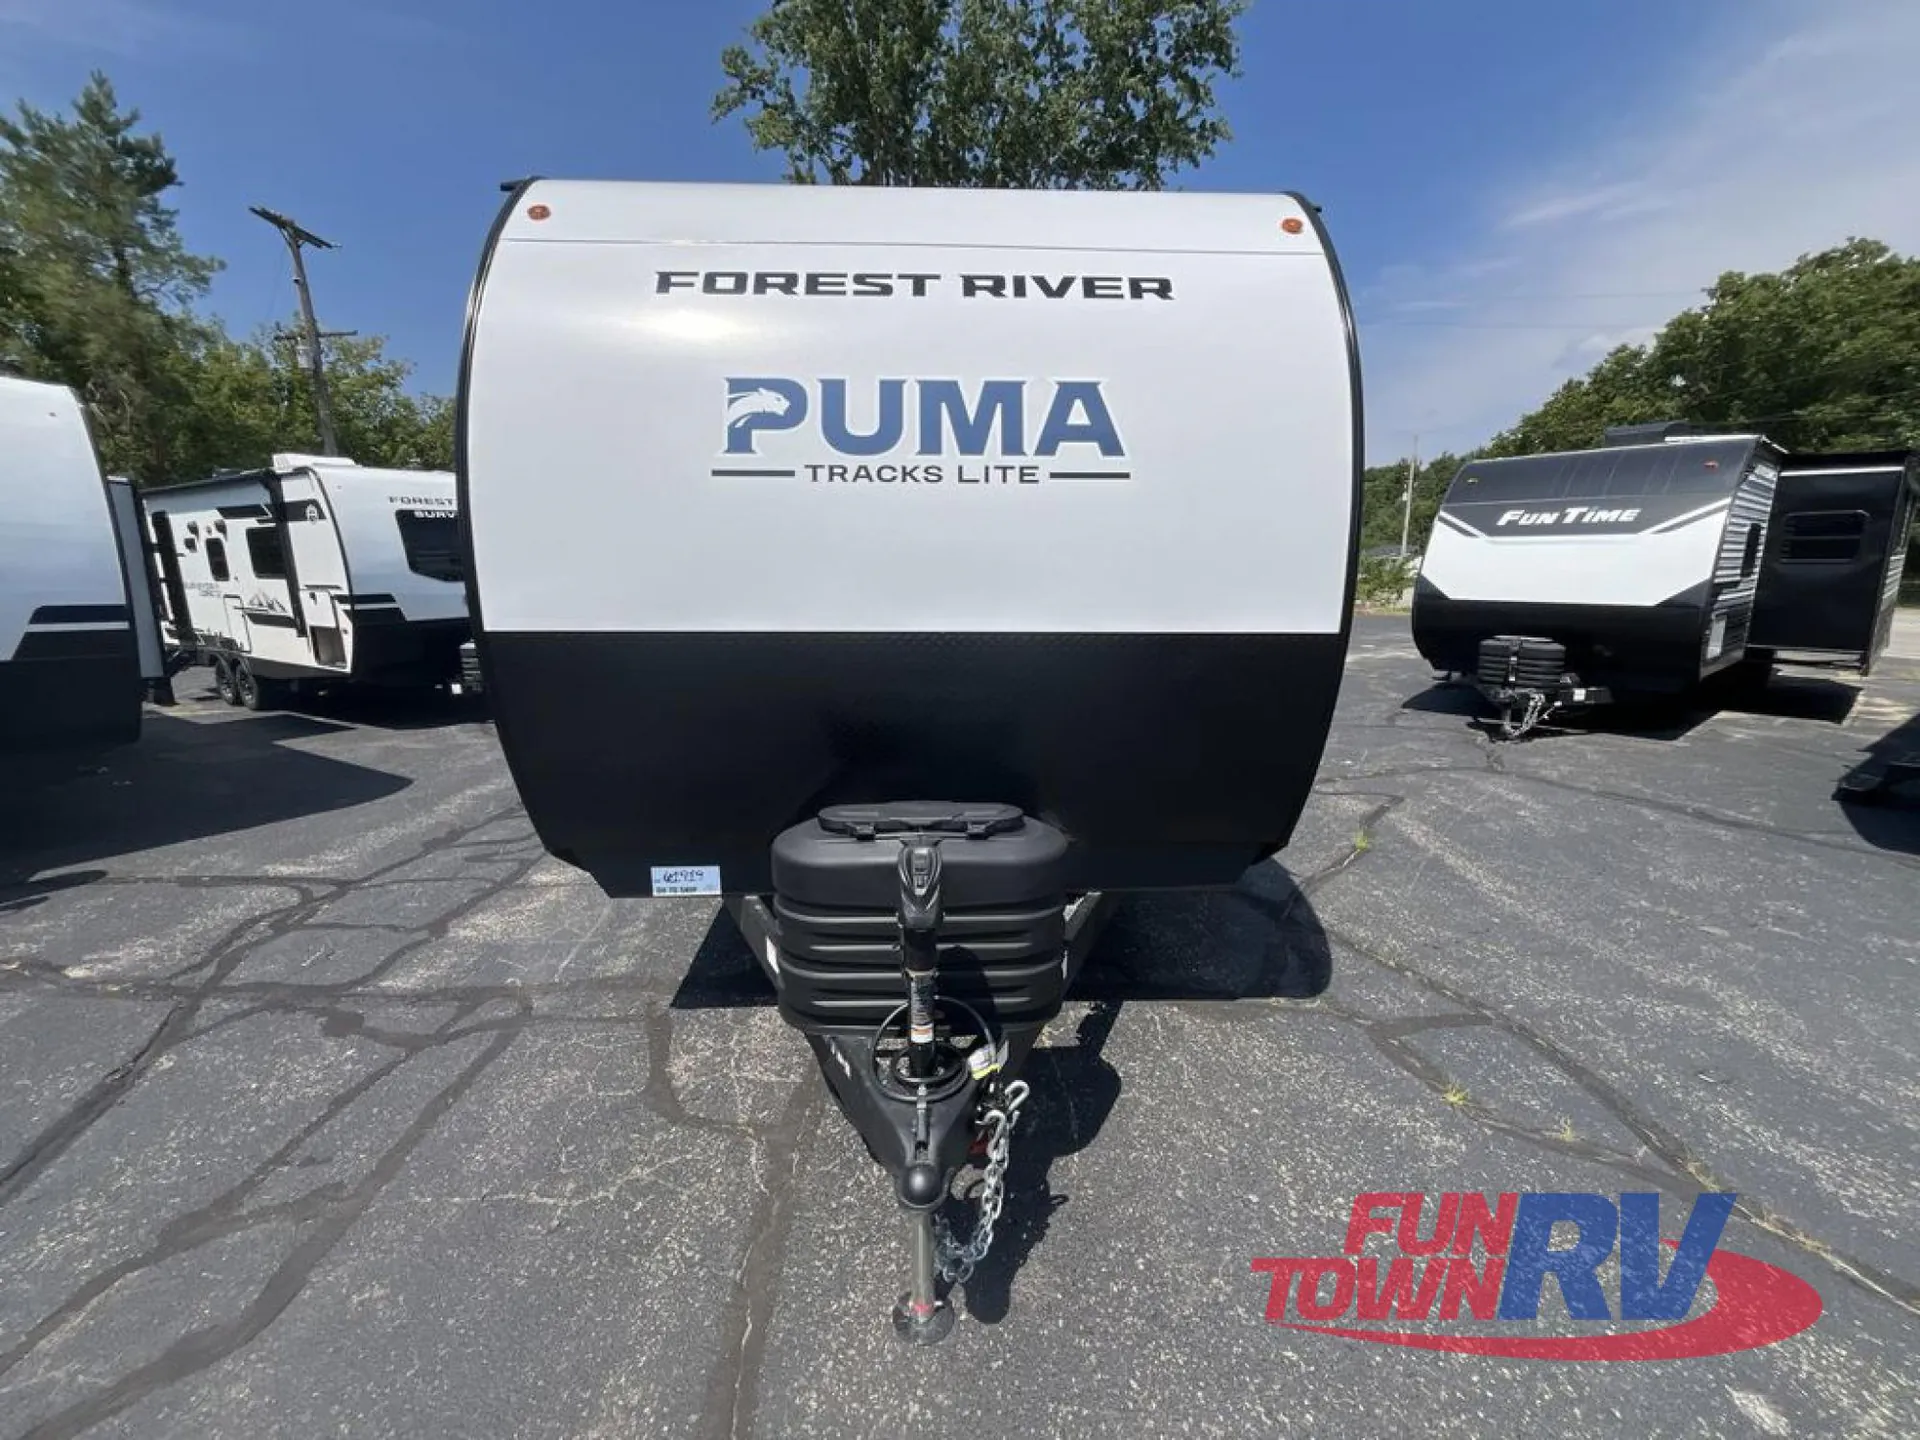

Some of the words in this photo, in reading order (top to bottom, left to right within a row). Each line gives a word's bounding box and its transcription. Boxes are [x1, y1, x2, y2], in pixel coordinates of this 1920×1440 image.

[656, 271, 941, 298] FOREST
[961, 274, 1175, 299] RIVER
[724, 377, 1126, 457] PUMA
[805, 463, 944, 484] TRACKS
[958, 465, 1040, 485] LITE
[389, 496, 453, 504] FOREST
